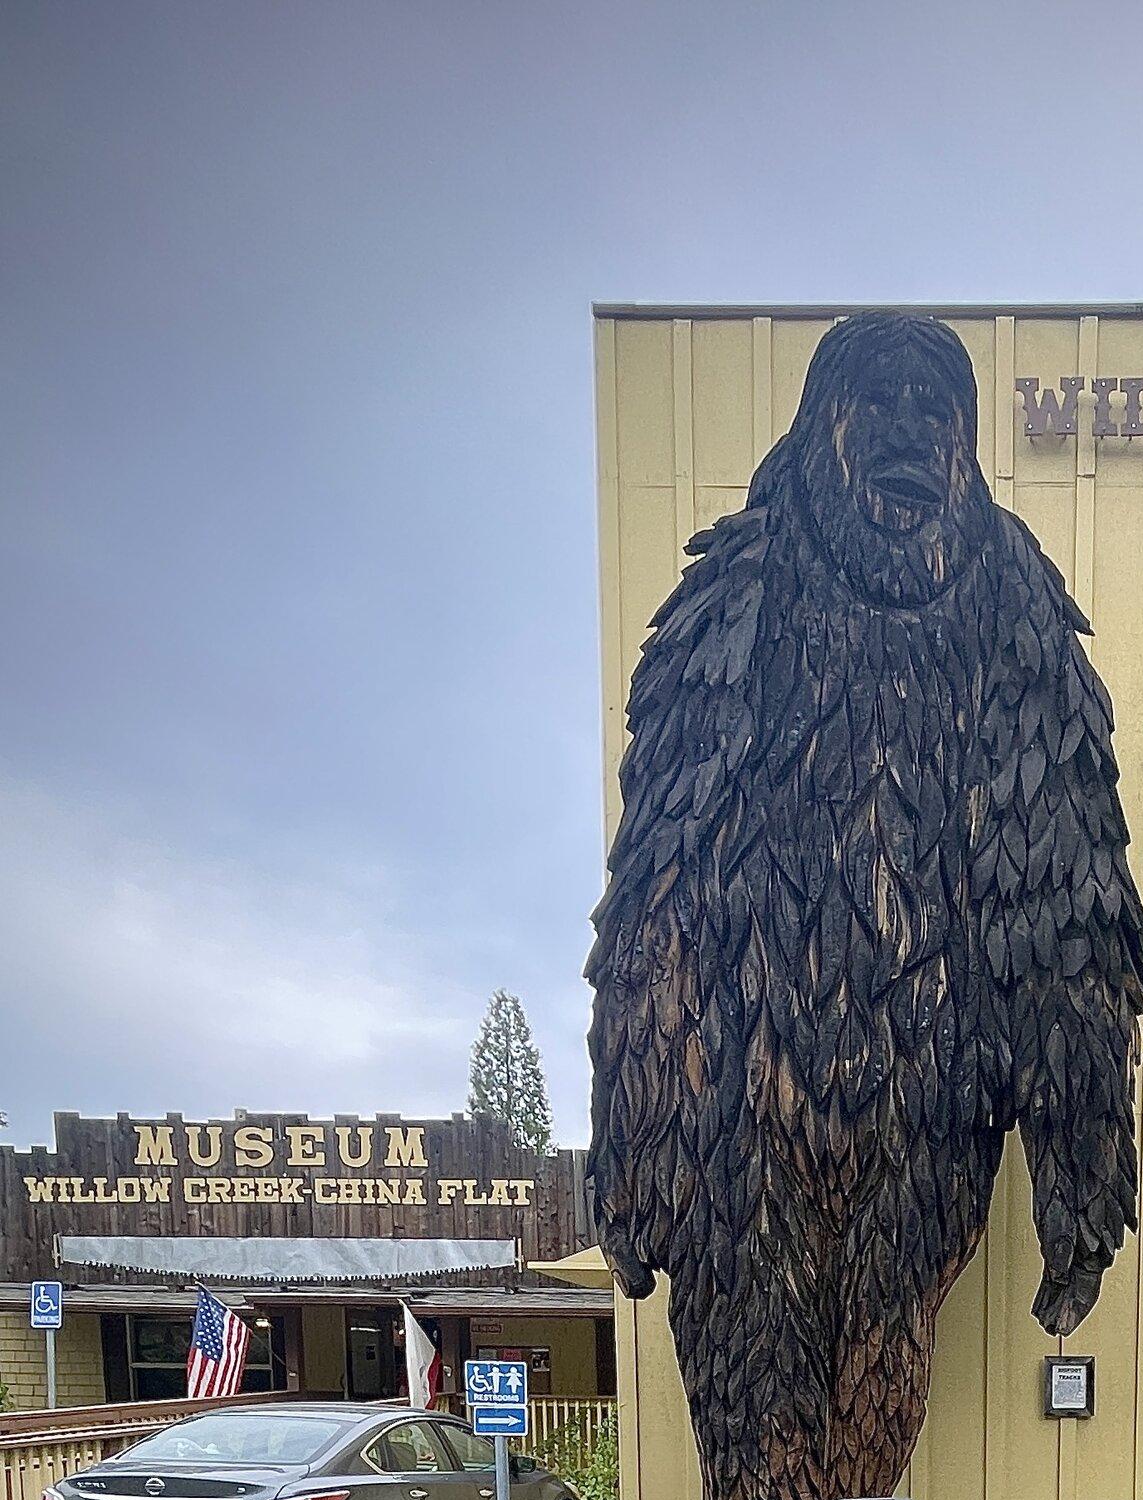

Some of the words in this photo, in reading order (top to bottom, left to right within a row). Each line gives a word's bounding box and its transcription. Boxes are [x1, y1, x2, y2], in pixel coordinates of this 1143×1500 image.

[134, 1125, 428, 1168] MUSEUM
[23, 1177, 172, 1203] WILLOW
[183, 1177, 427, 1205] CREEK-CHINA
[438, 1179, 535, 1206] FLAT
[473, 1393, 520, 1402] RESTROOMS
